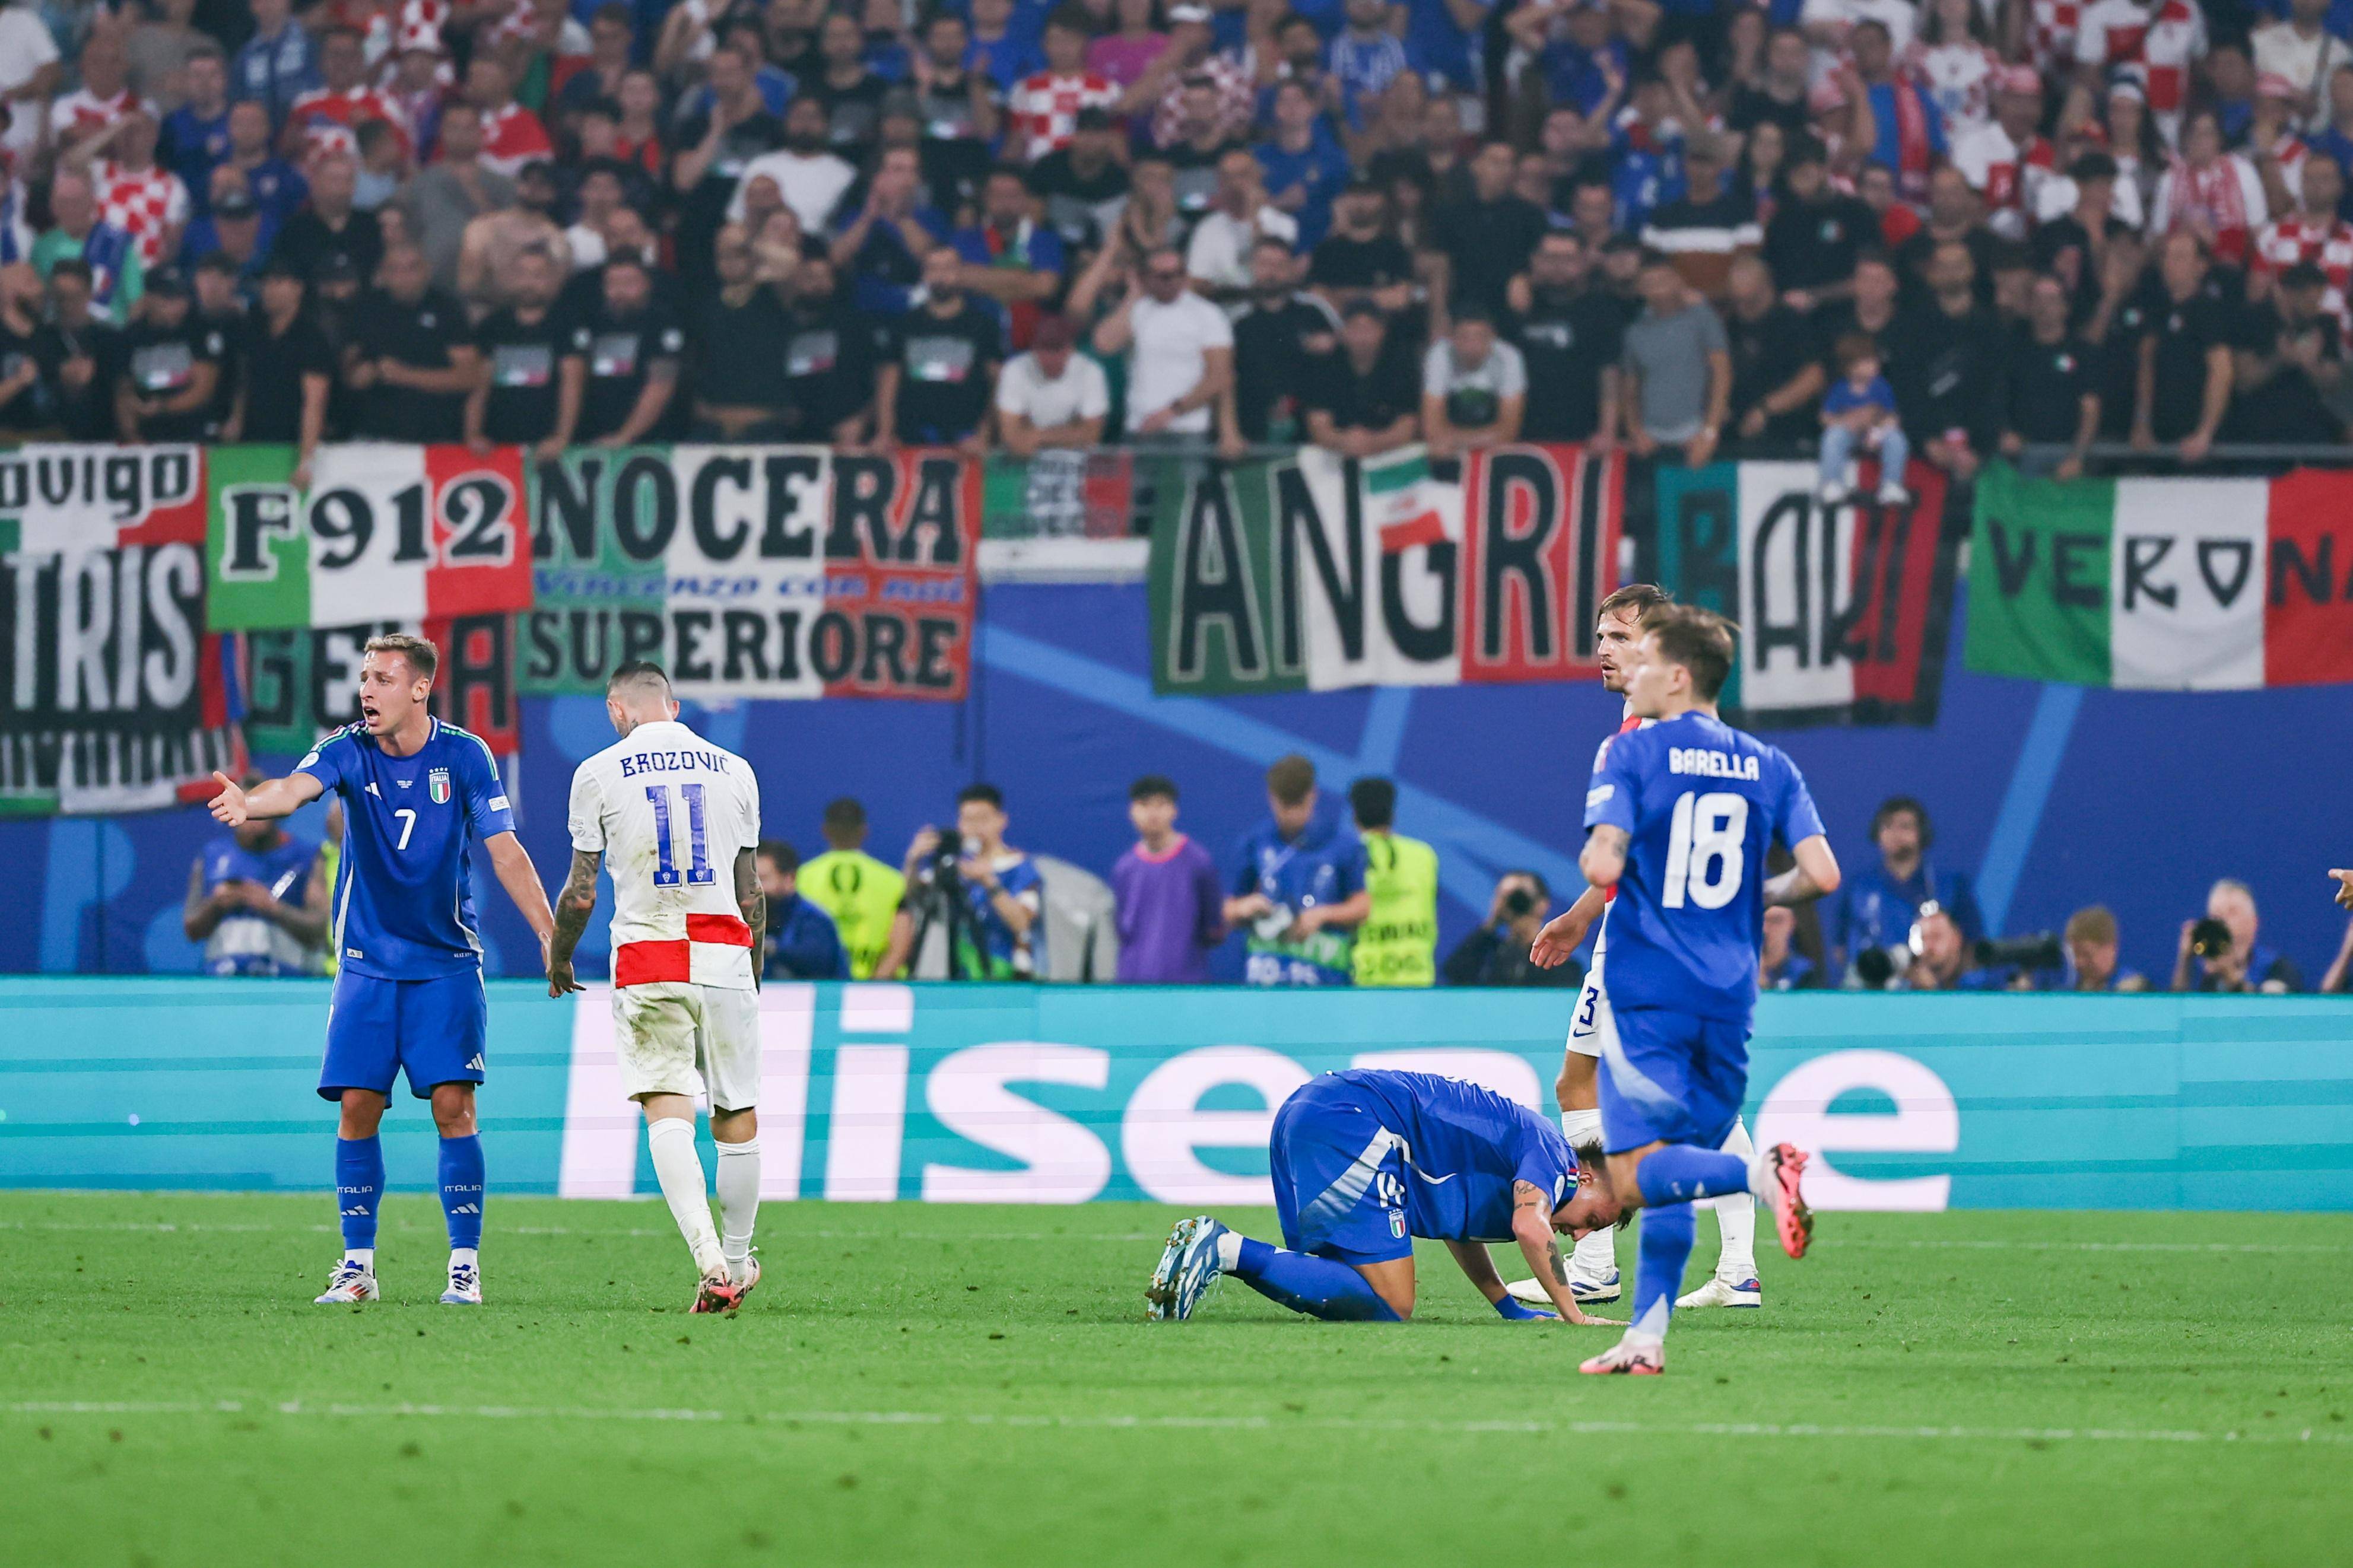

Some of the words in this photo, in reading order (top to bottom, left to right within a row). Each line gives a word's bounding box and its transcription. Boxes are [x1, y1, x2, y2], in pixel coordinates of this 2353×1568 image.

[229, 477, 507, 572] F912
[532, 455, 964, 562] NOCERA
[1177, 453, 1602, 673] ANGRI
[1987, 518, 2353, 612] VERON
[246, 615, 512, 733] GEA
[528, 608, 957, 687] SUPERIORE
[1669, 748, 1760, 781] BARELLA
[395, 809, 416, 850] 7
[646, 784, 716, 888] 11
[1663, 791, 1749, 909] 18
[1579, 987, 1599, 1026] 3
[1377, 1172, 1405, 1208] 14
